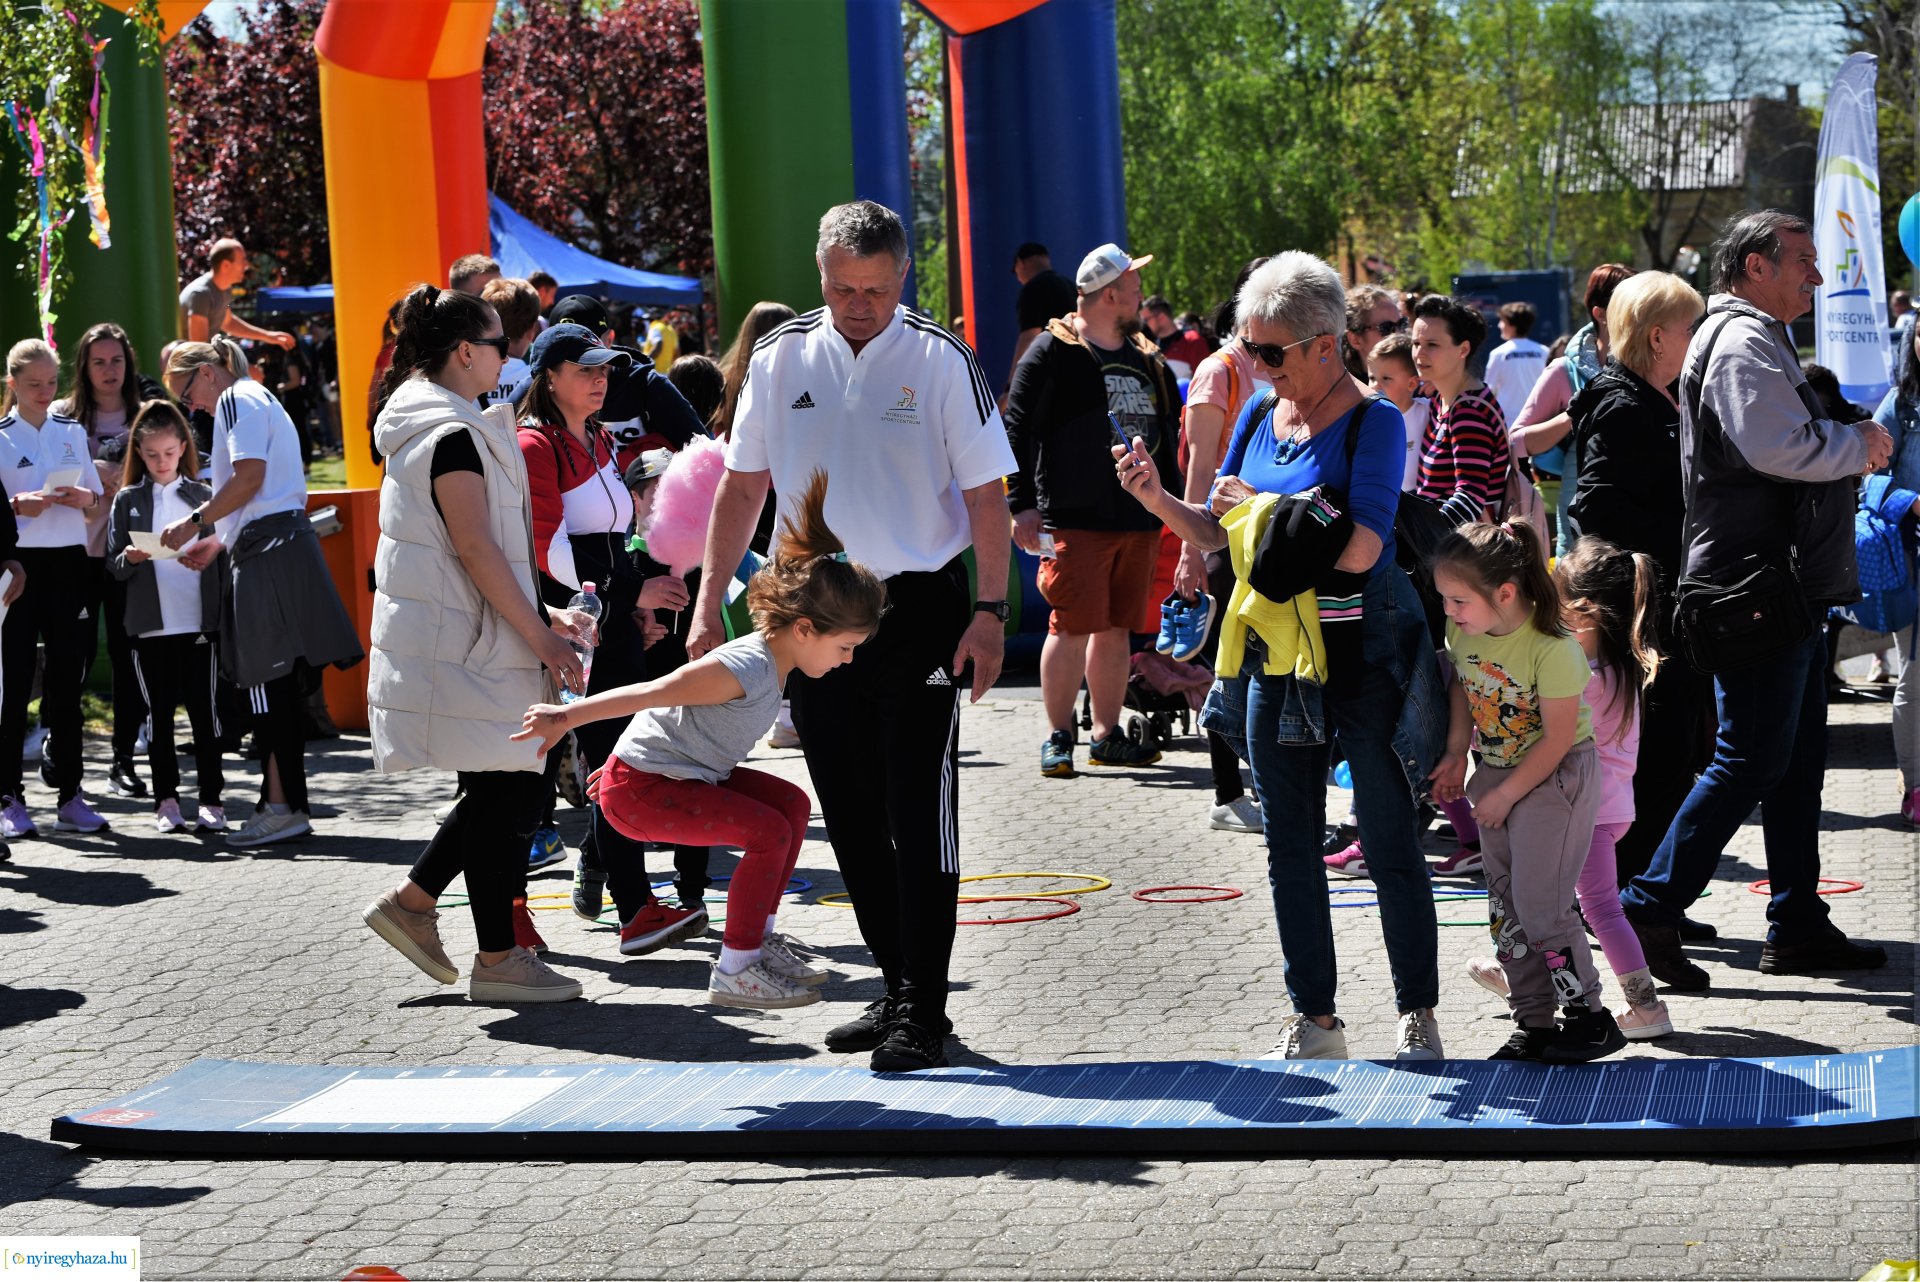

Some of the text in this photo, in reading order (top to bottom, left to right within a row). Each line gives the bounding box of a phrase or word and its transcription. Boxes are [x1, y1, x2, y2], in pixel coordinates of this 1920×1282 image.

[1104, 375, 1144, 393] STAR
[791, 402, 816, 410] adidas
[926, 678, 952, 686] adidas
